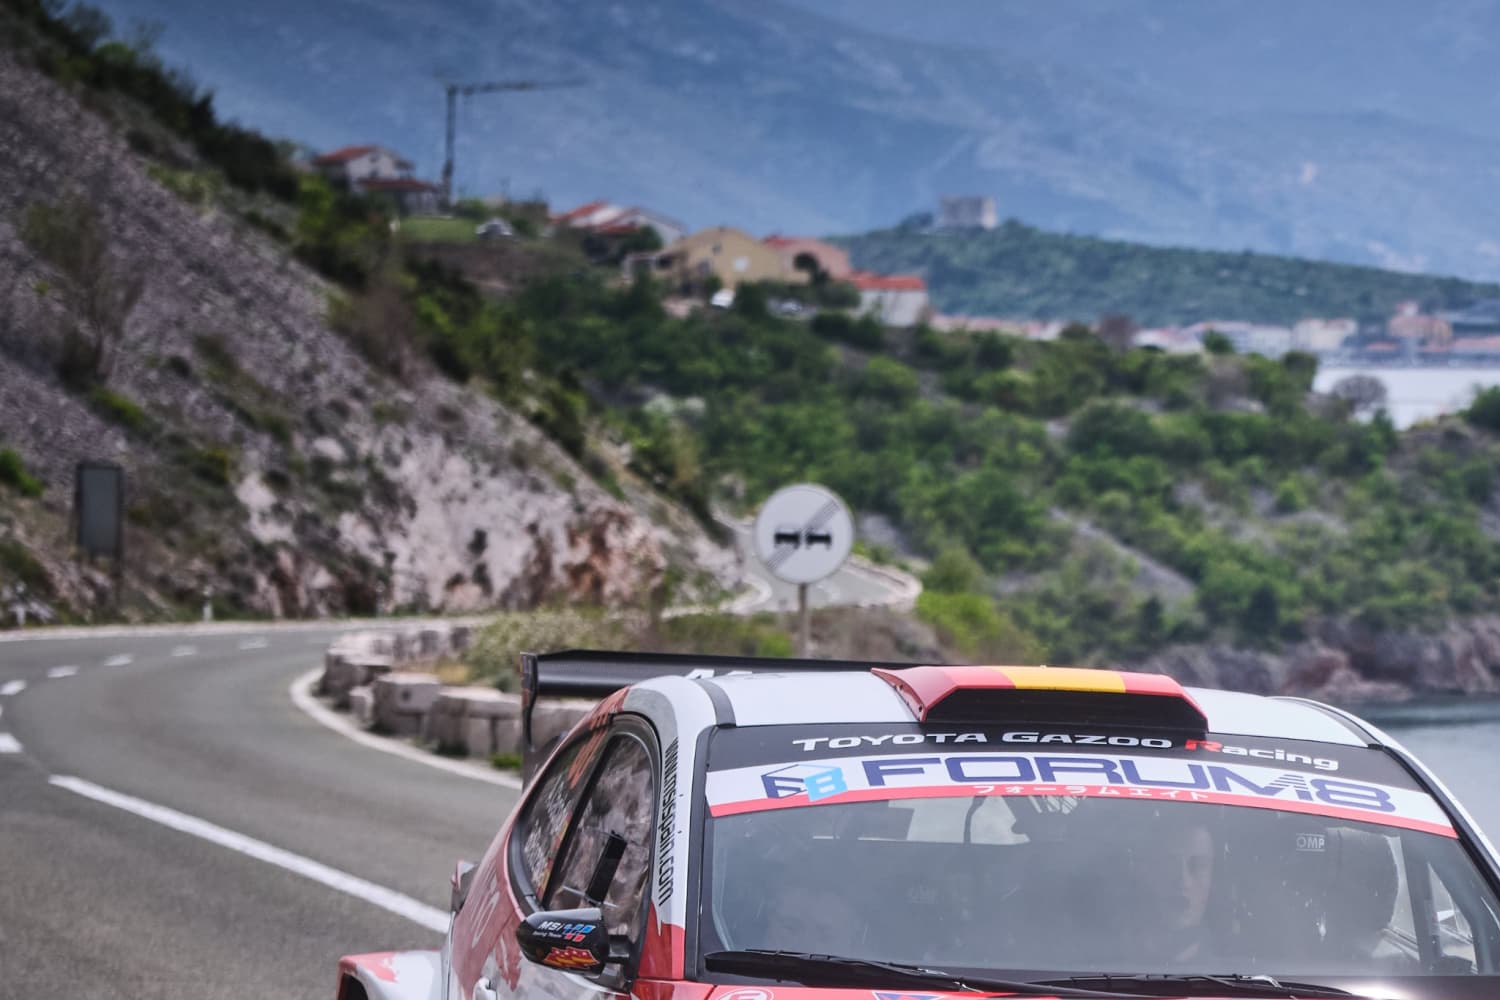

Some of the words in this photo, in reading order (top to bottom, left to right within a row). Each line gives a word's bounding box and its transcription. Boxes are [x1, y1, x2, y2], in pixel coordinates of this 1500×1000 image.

[793, 733, 988, 751] TOYOTA
[1002, 732, 1172, 749] GAZOO
[1185, 739, 1339, 771] Racing
[862, 756, 1396, 813] FORUM8
[1296, 836, 1325, 850] OMP
